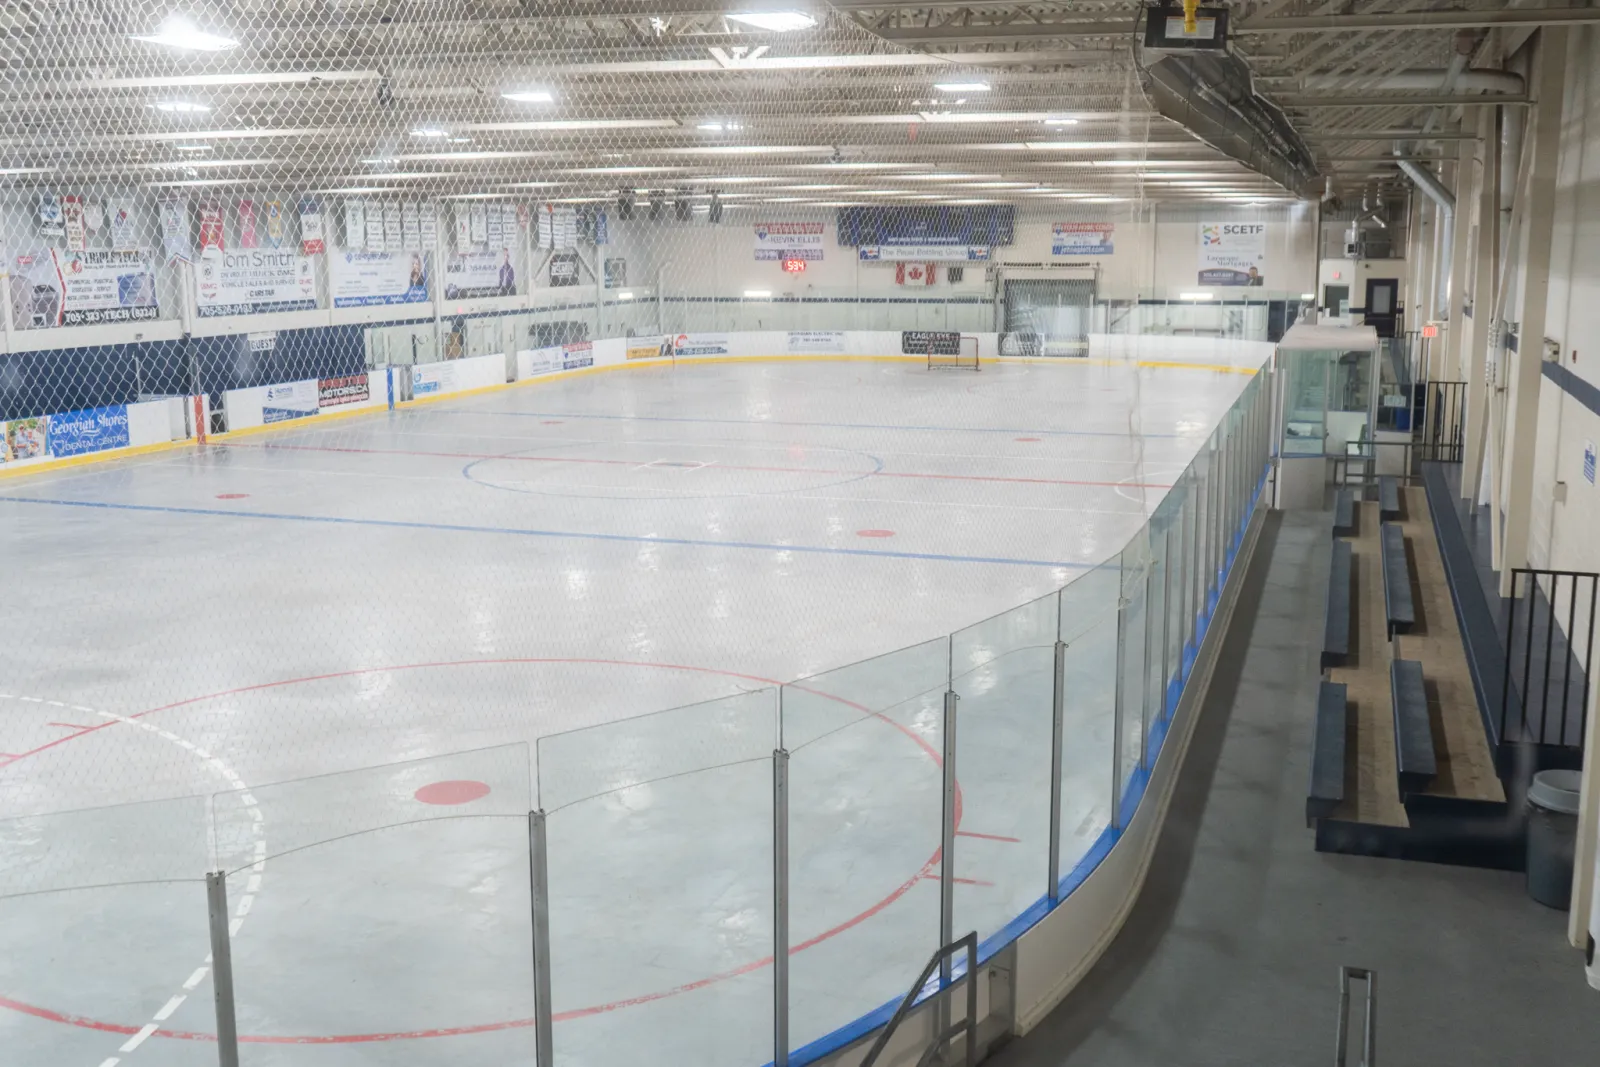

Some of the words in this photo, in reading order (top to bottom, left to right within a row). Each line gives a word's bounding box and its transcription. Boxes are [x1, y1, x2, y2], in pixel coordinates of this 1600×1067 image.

[1223, 224, 1264, 235] SCETF
[797, 235, 821, 243] ELLIS
[882, 248, 894, 256] The
[223, 251, 249, 268] Tom
[251, 250, 295, 268] Smith
[49, 416, 95, 437] Georgian
[96, 413, 128, 428] Shores
[65, 441, 95, 451] DENTAL
[97, 435, 128, 446] CENTRE
